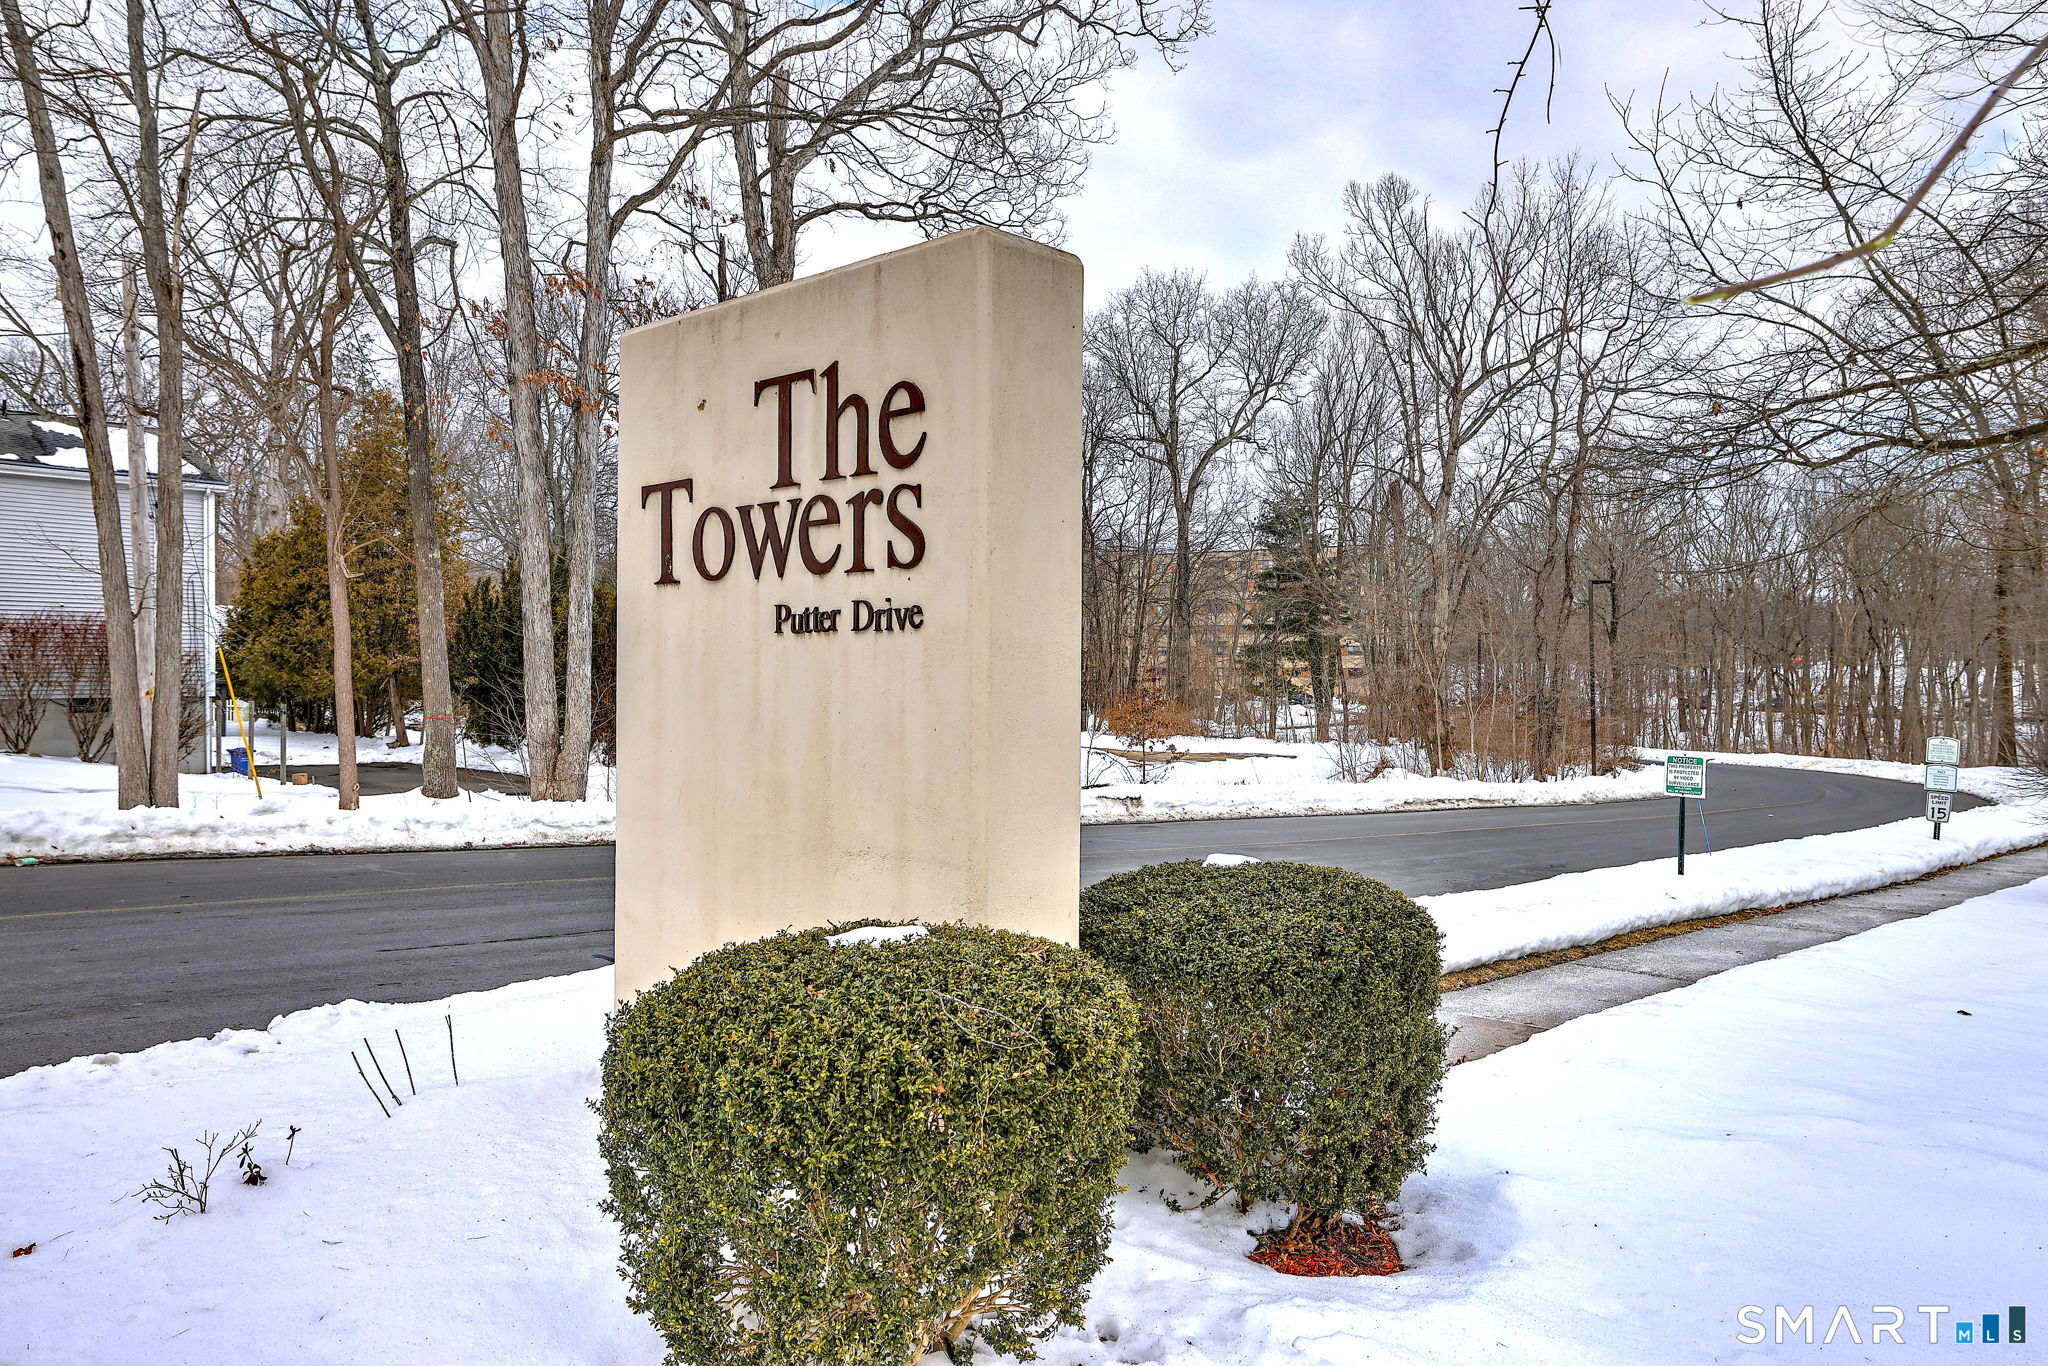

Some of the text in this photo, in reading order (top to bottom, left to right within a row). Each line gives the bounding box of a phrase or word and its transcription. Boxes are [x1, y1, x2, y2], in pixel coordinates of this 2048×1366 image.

[754, 360, 927, 490] The
[641, 478, 926, 585] Towers
[774, 598, 924, 634] Putter Drive
[1931, 807, 1946, 819] 15
